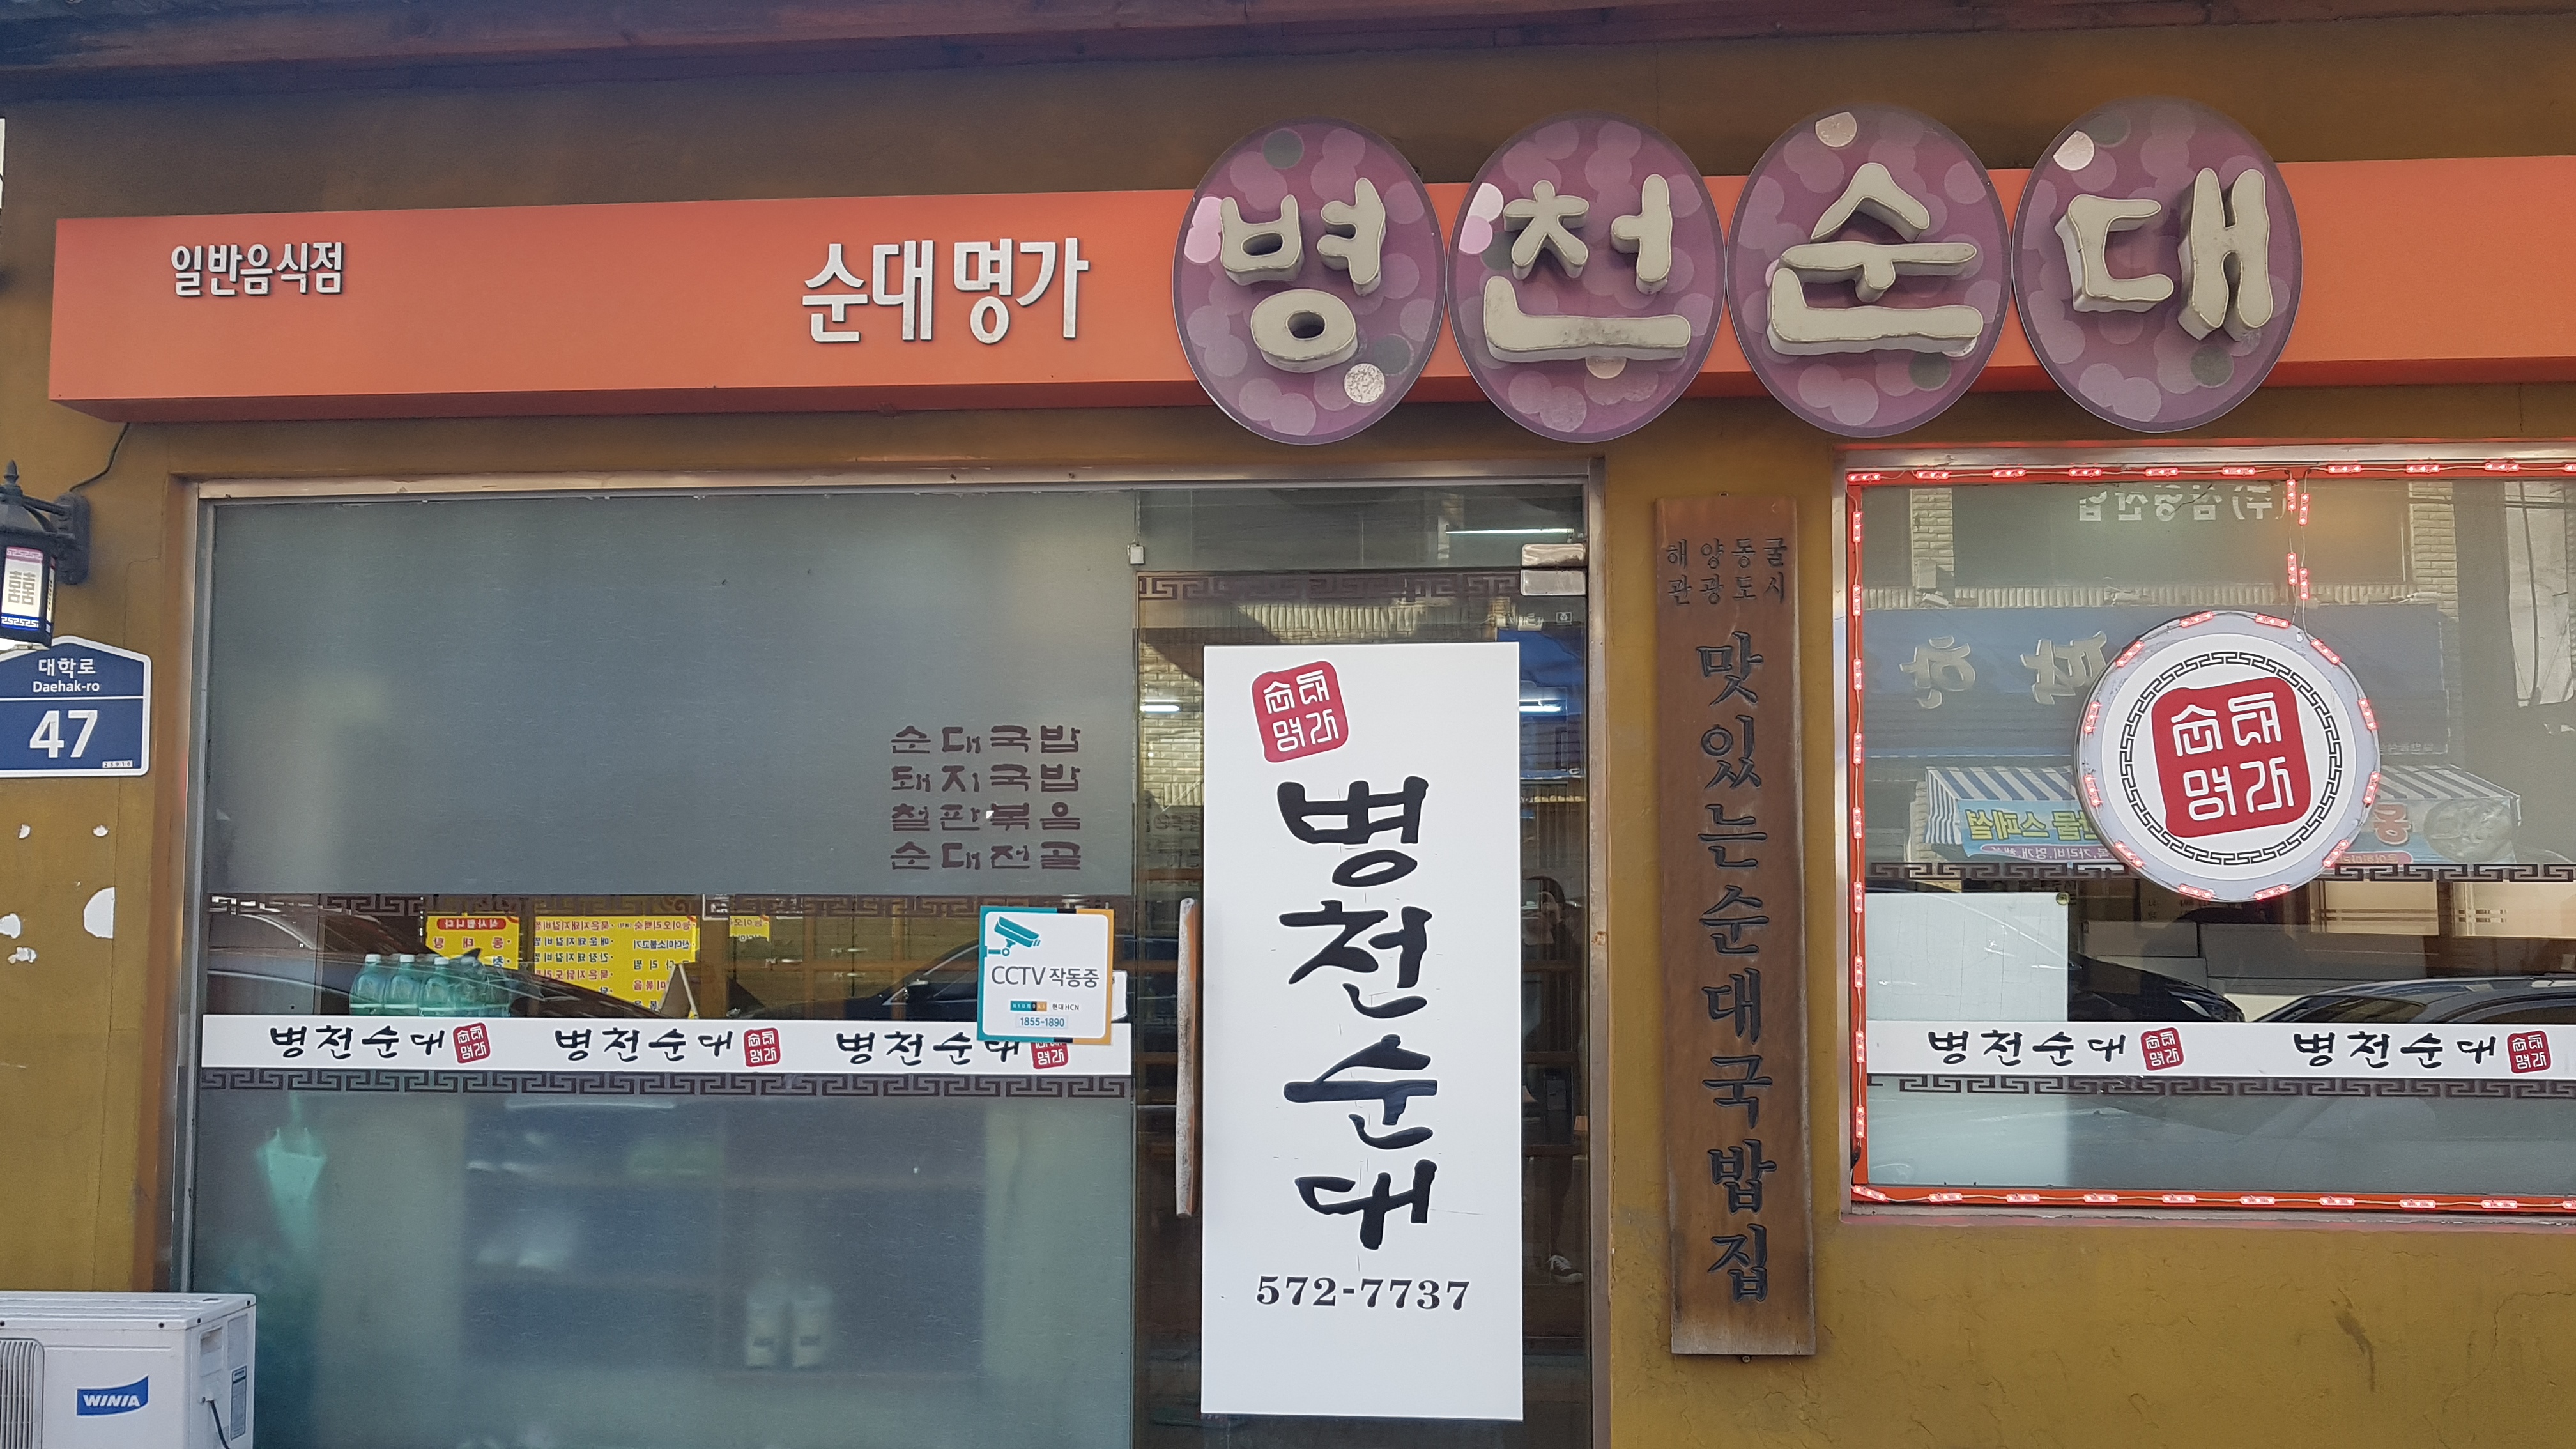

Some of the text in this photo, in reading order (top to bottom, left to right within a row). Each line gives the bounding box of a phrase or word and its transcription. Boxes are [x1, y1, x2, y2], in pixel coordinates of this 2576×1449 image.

[170, 241, 344, 297] 일반음식점
[1219, 162, 2273, 374] 병천순대
[802, 237, 1090, 345] 순대 명가
[1666, 537, 1788, 571] 해양동굴
[1667, 572, 1786, 606] 관광도시
[38, 657, 96, 679] 대학로
[32, 680, 100, 693] Daehak-ro
[29, 709, 98, 759] 47
[891, 725, 1081, 754] 순대국밥
[891, 763, 1081, 792] 돼지국밥
[891, 801, 1081, 831] 철판볶음
[890, 841, 1081, 870] 순대전골
[991, 965, 1046, 986] CCTV
[1048, 967, 1100, 988] 작동중
[1012, 1002, 1046, 1010] HYUNDAI
[1052, 1002, 1064, 1011] 현대
[1020, 1016, 1065, 1027] 1855-1890
[1276, 775, 1439, 1251] 병천순대
[269, 1025, 446, 1060] 병천순대
[554, 1027, 733, 1062] 병천순대
[1928, 1029, 2127, 1066] 병천순대
[2294, 1030, 2497, 1068] 병천순대
[1255, 1275, 1470, 1311] 572-7737
[82, 1394, 141, 1407] WINIA
